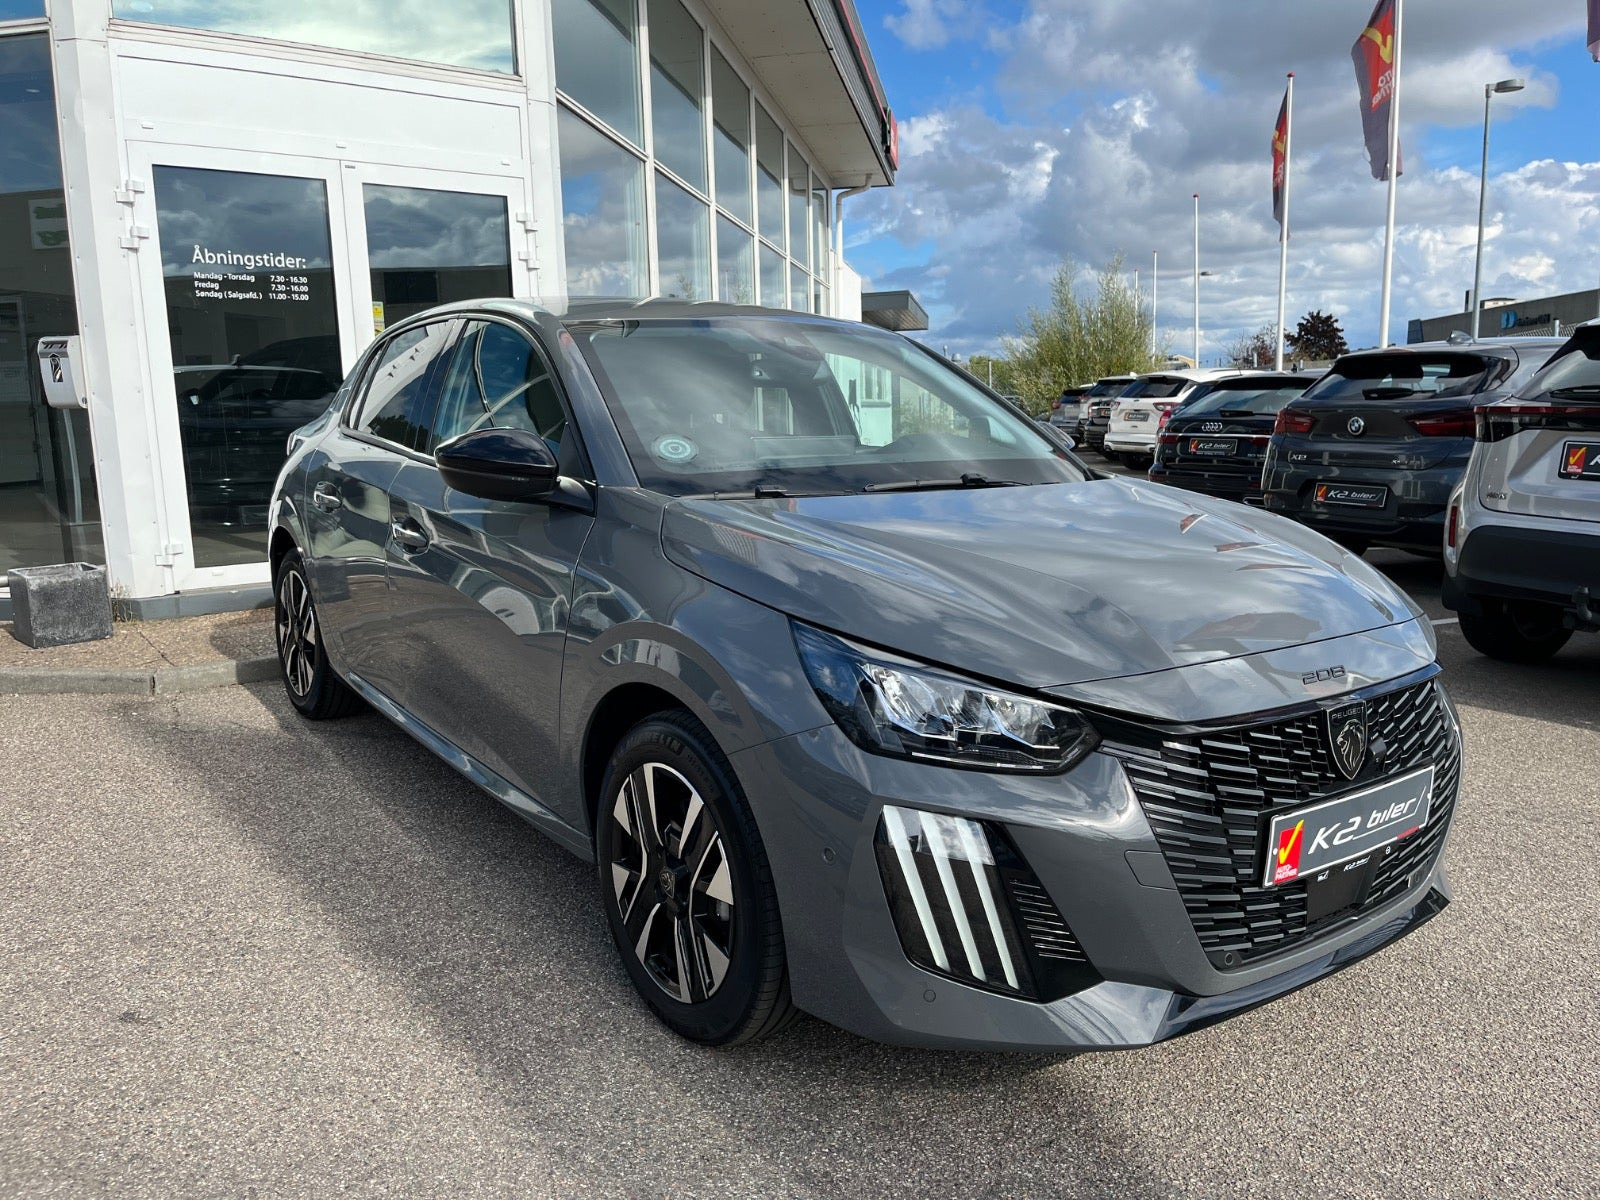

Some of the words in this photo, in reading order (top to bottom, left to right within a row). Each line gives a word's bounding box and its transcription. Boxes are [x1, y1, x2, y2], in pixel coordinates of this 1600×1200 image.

[192, 244, 306, 269] Åbningstider:
[193, 272, 223, 281] Mandag
[228, 273, 256, 283] Torsdag
[270, 275, 285, 283] 7.30
[290, 276, 308, 284] 16.30
[194, 281, 220, 290] Fredag
[271, 284, 286, 292] 7.30
[290, 285, 309, 293] 16.00
[195, 290, 223, 299] Søndag
[268, 292, 287, 300] 11.00
[291, 293, 310, 301] 15.00
[1327, 490, 1349, 498] K2
[1301, 665, 1345, 685] 208
[1331, 706, 1364, 719] PEUGEOT
[1307, 815, 1362, 855] K2
[1366, 797, 1417, 829] biler
